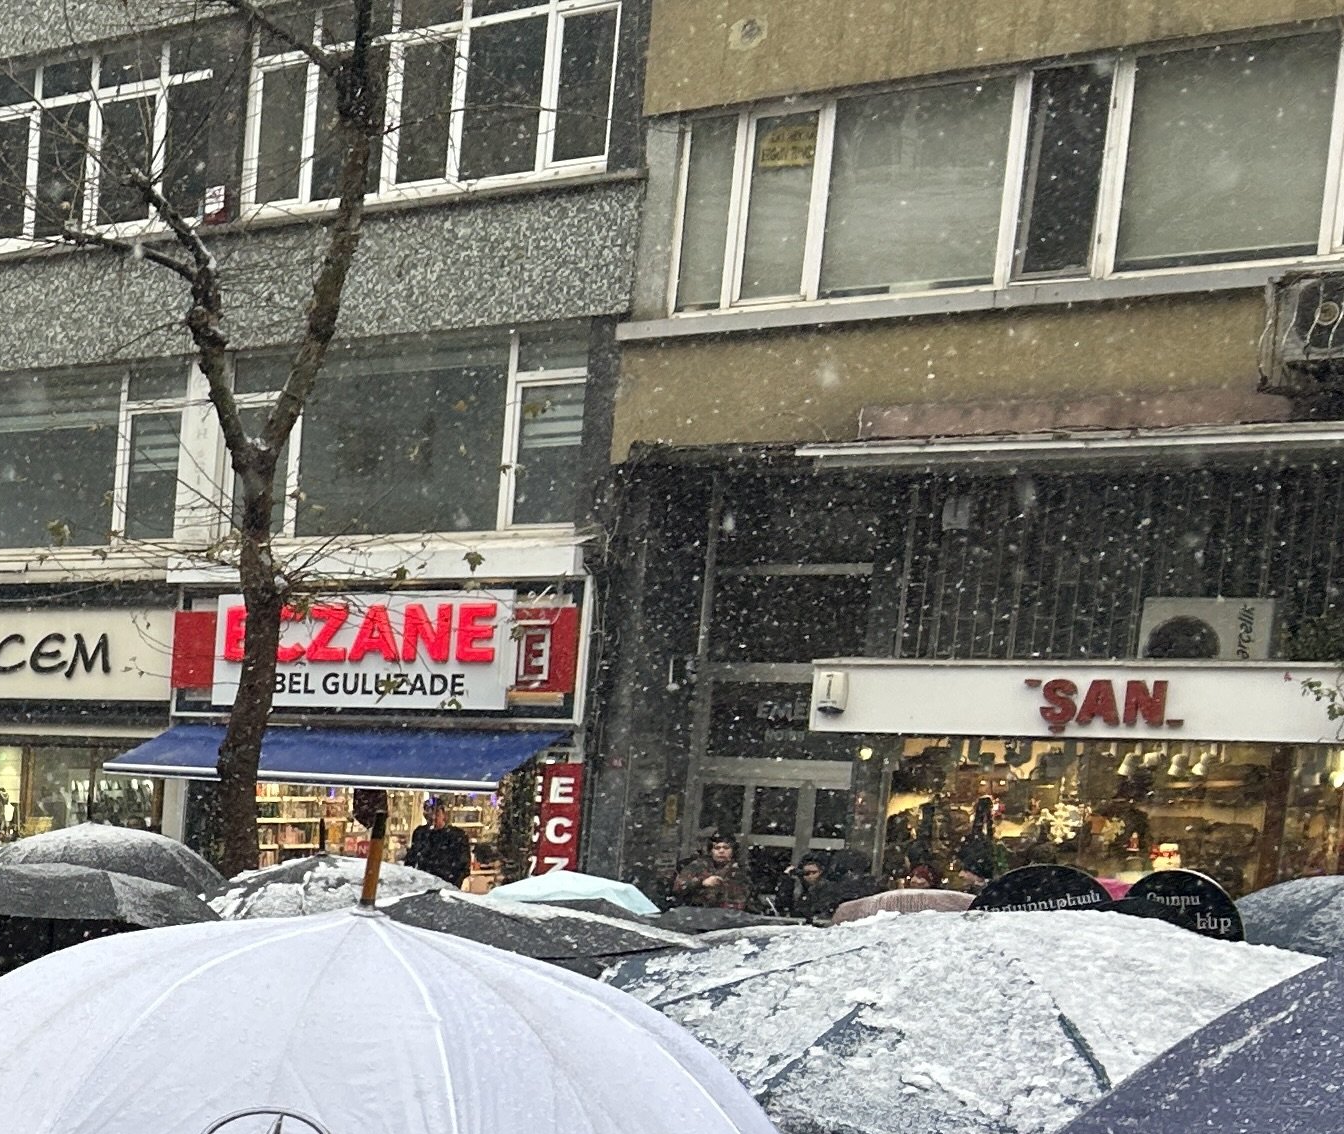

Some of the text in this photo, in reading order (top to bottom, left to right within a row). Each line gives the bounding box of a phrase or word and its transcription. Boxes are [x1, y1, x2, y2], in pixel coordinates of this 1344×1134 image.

[224, 603, 498, 664] ECZANE
[526, 634, 545, 677] E
[273, 673, 313, 695] BEL
[1039, 677, 1170, 734] ŞAN
